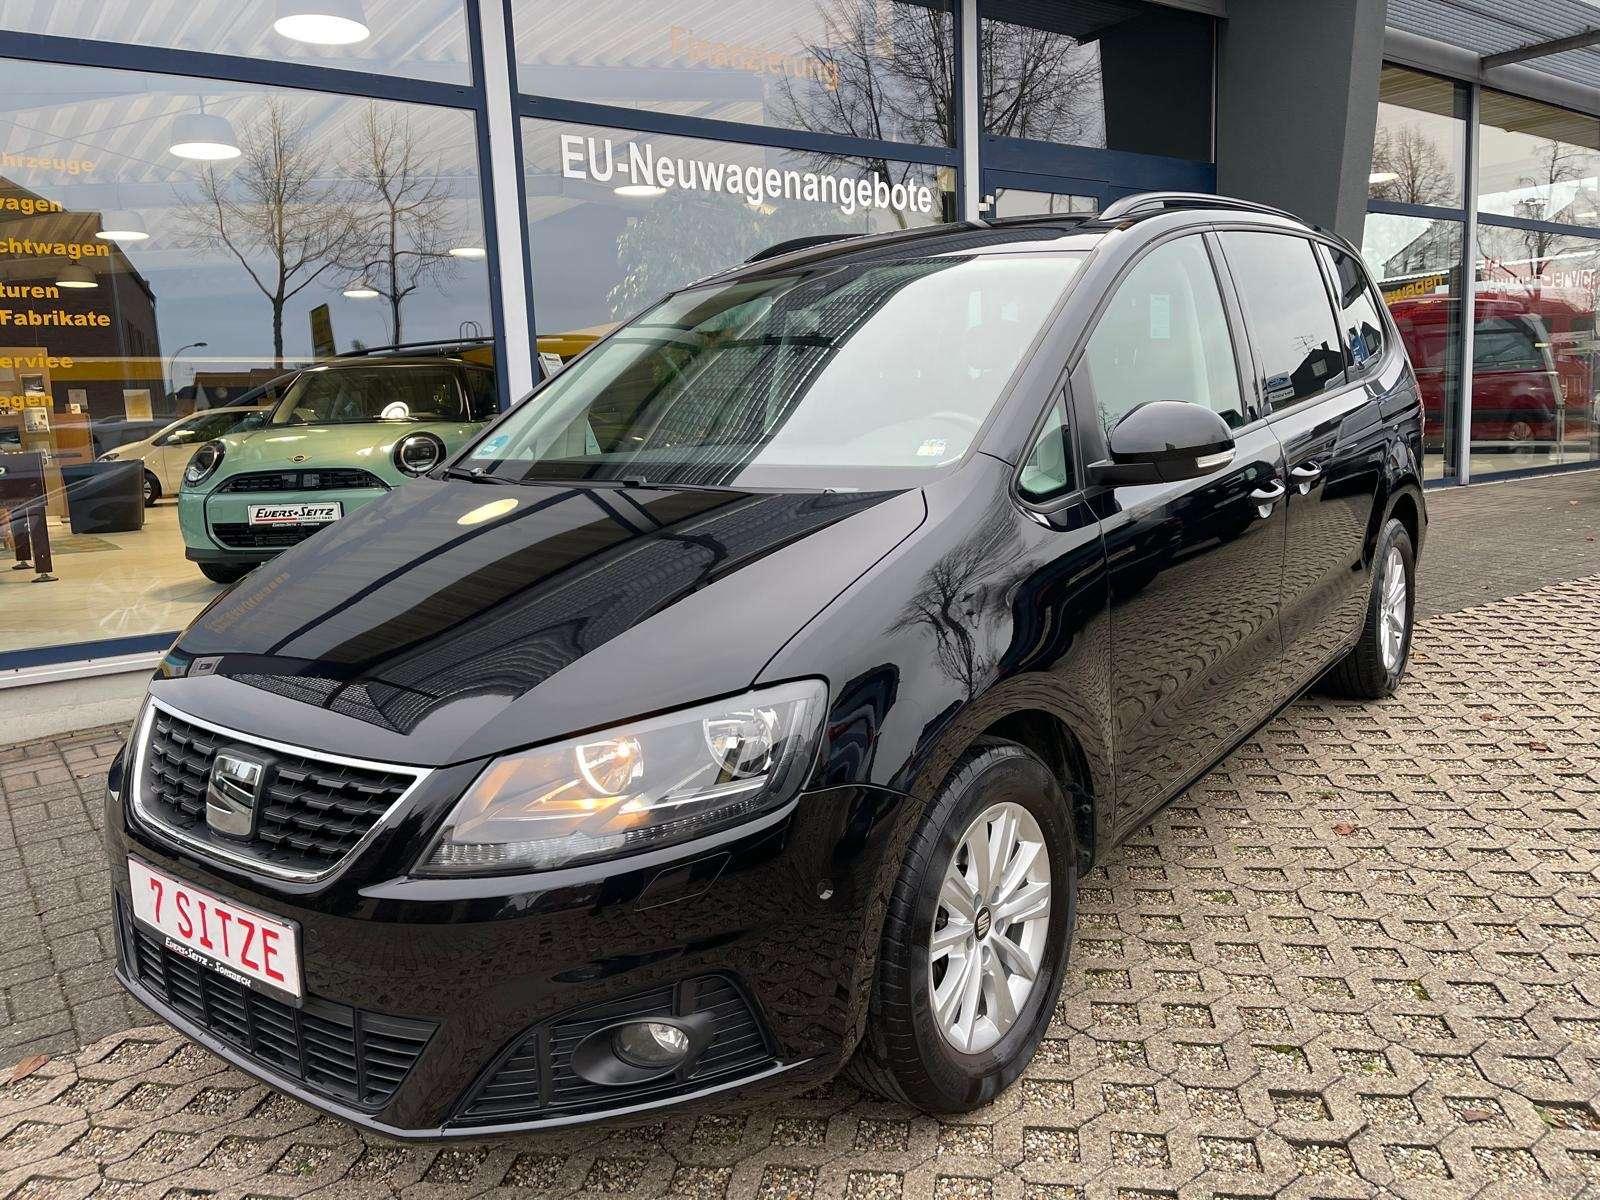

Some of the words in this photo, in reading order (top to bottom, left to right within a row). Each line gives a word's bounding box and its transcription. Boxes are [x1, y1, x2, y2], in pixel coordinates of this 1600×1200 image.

[560, 133, 932, 215] EU-Neuwagenangebote
[0, 310, 111, 327] Fabrikate
[150, 877, 163, 923] 7
[175, 890, 285, 982] SITZE
